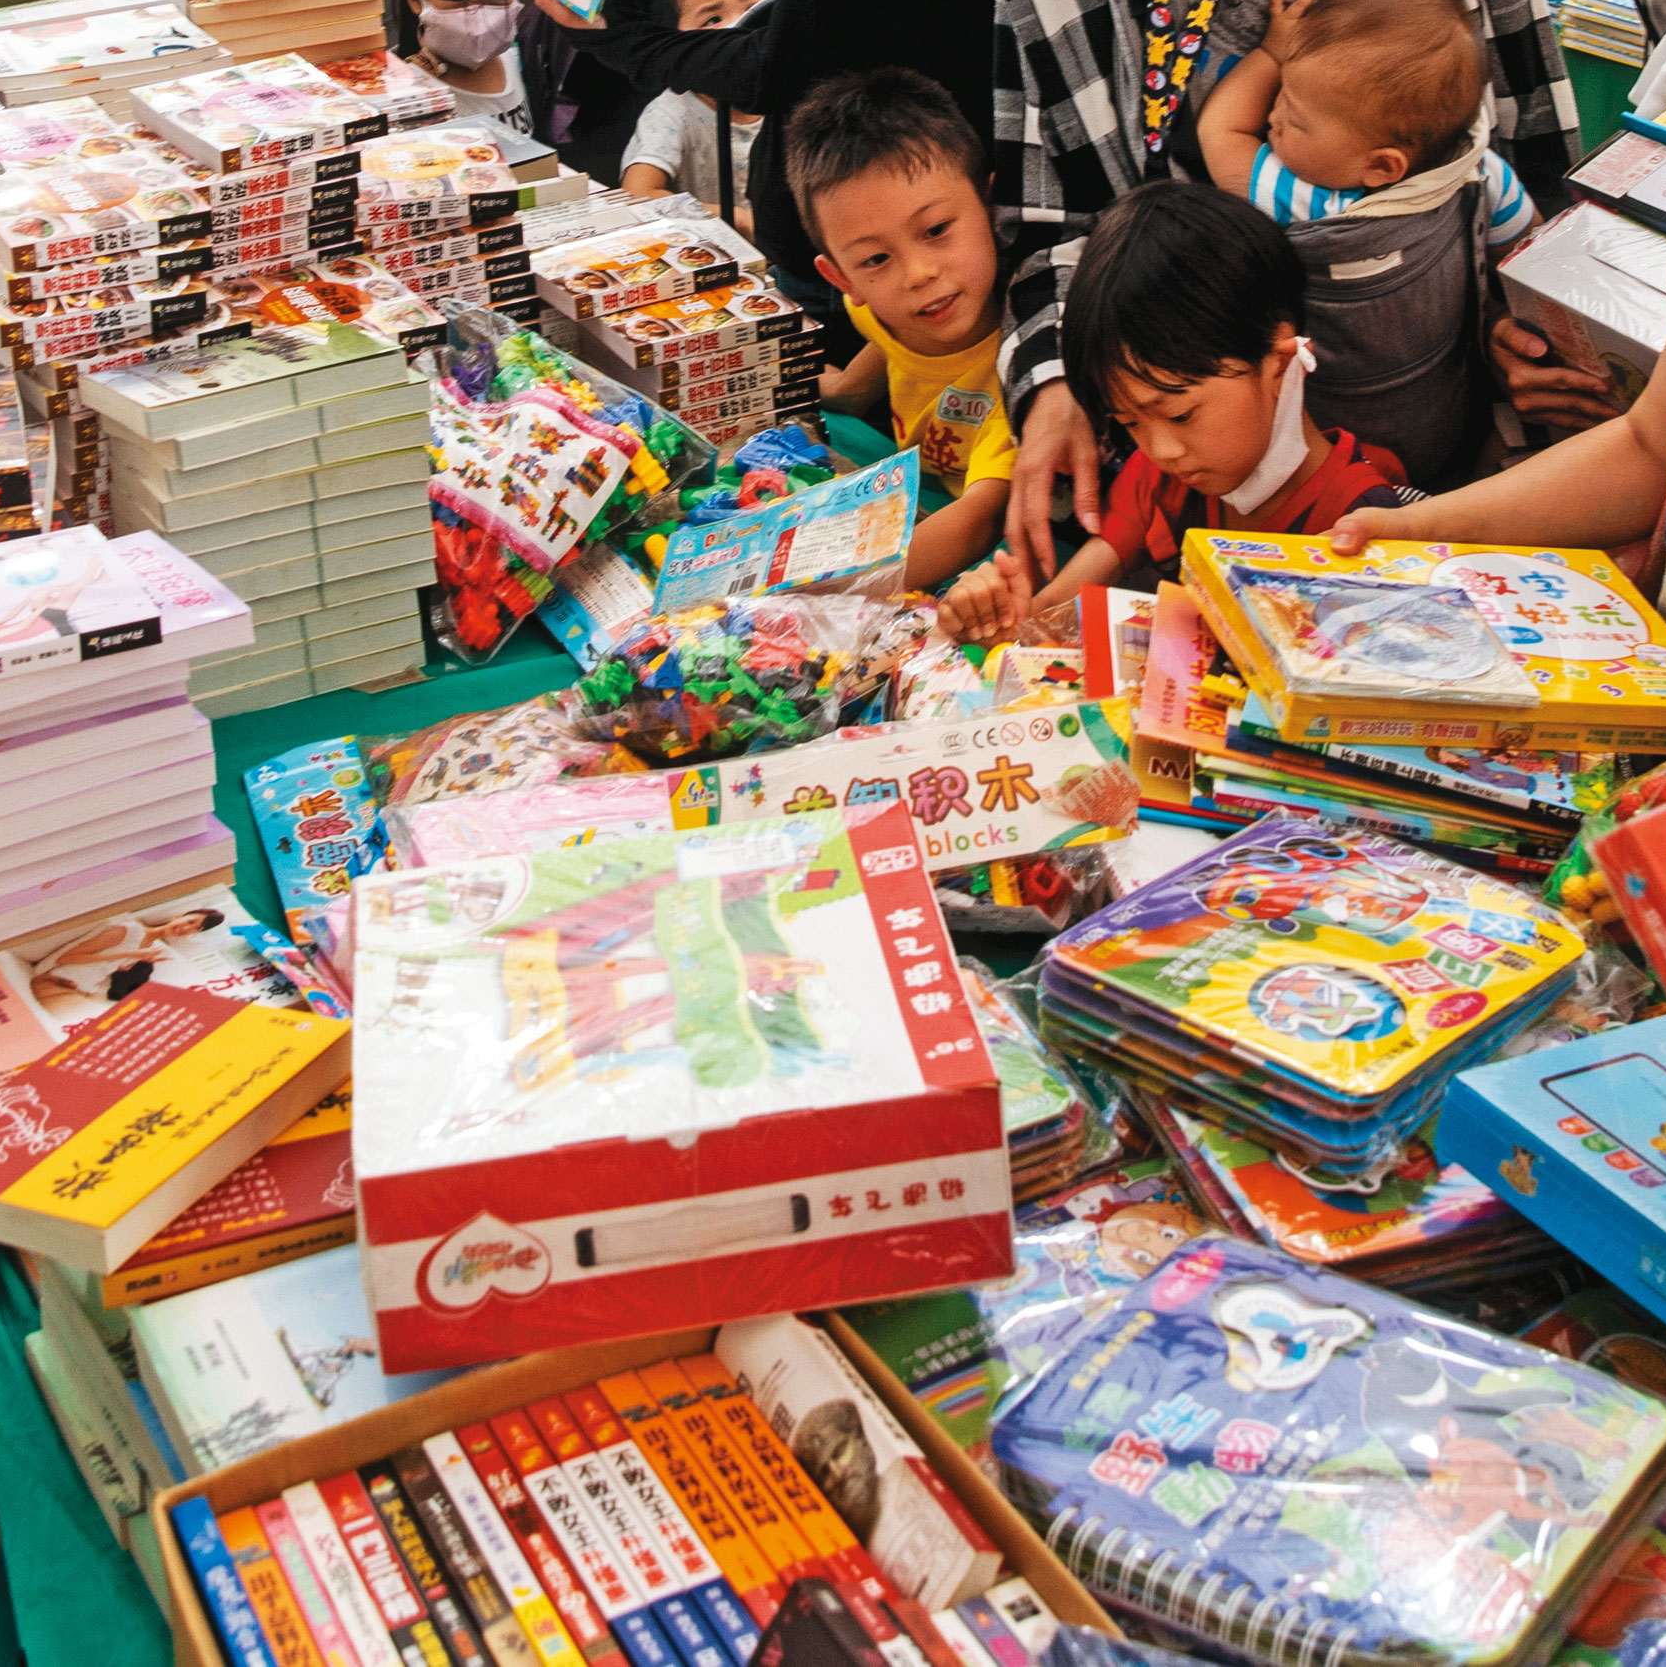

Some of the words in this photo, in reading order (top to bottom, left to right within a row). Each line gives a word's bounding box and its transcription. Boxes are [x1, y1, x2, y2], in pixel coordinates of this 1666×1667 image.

[367, 199, 433, 223] 米飯料理
[853, 478, 872, 499] CE
[1454, 565, 1567, 600] 數字
[972, 726, 999, 749] CE
[925, 823, 1020, 858] blocks
[880, 907, 958, 1017] 极速飞车
[827, 1175, 966, 1221] 极速飞车
[575, 1457, 670, 1590] 不敗女王朴槿惠
[613, 1446, 710, 1575] 不敗女王朴槿惠
[537, 1475, 631, 1605] 不敗女王朴槿惠
